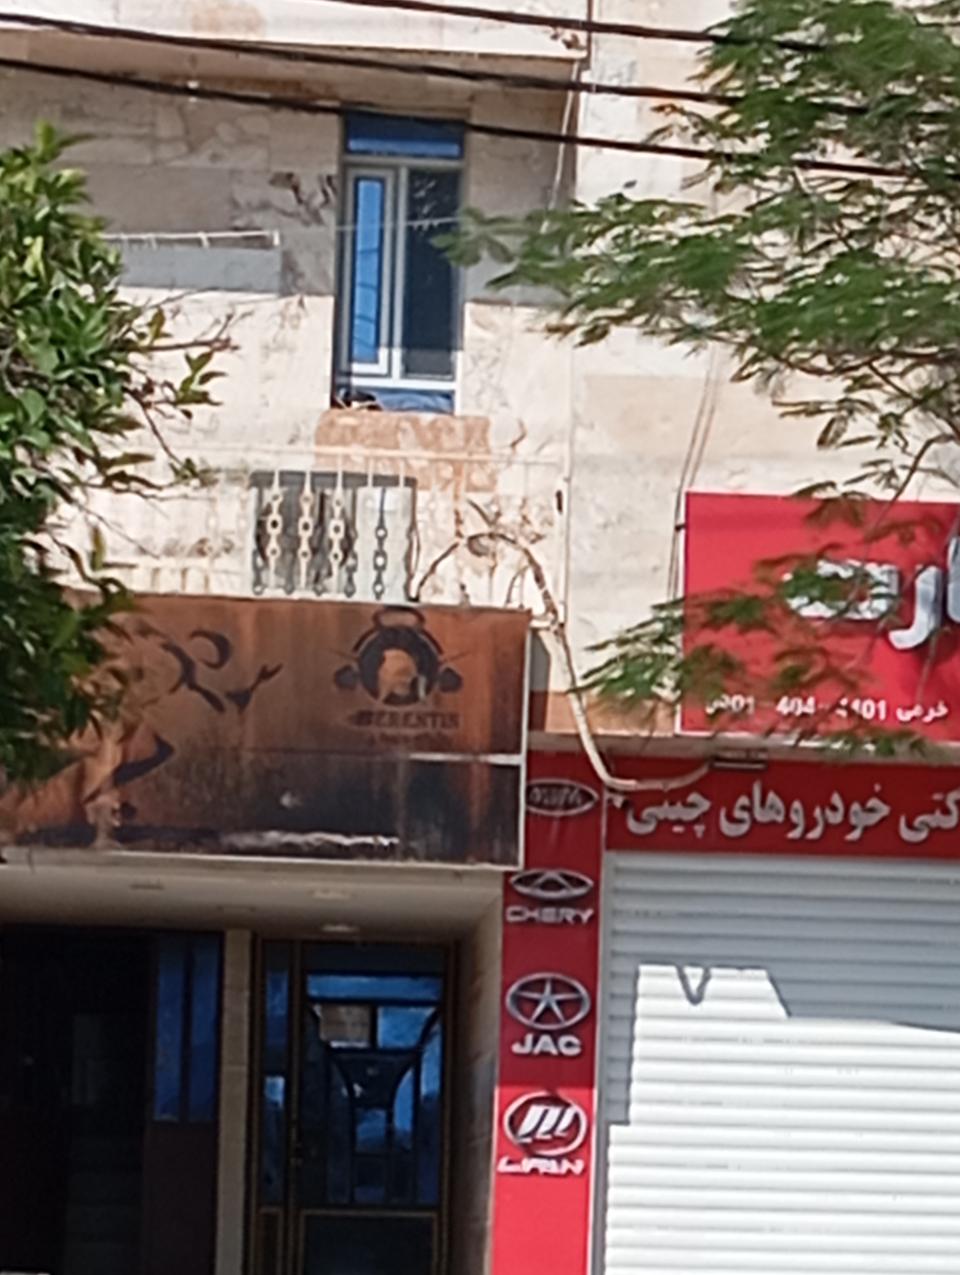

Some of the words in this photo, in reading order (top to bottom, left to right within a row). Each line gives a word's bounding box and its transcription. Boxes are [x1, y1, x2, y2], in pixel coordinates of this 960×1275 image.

[626, 791, 712, 838] چینی
[718, 779, 891, 841] خودروهای
[505, 905, 594, 925] CHERY
[511, 1033, 582, 1056] JAC
